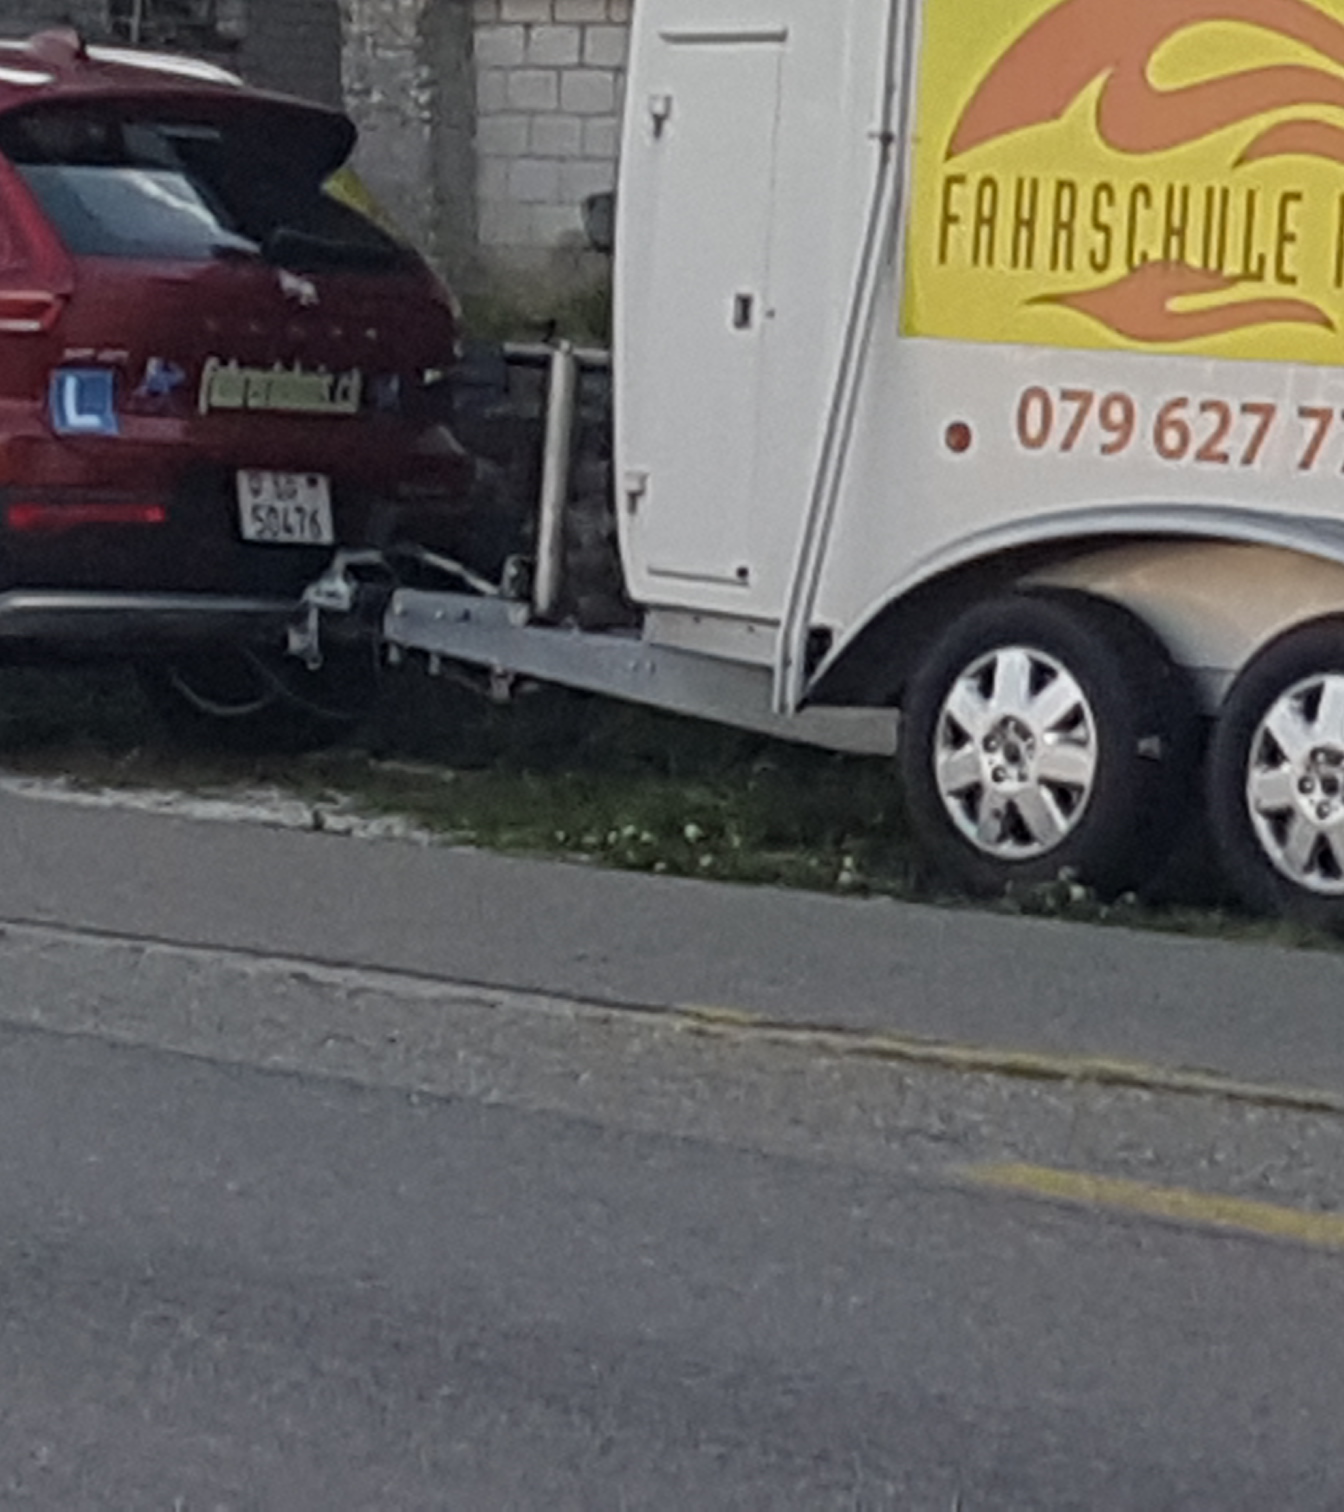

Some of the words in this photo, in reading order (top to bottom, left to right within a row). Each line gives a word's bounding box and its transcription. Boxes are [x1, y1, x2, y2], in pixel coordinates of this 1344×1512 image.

[938, 173, 1304, 287] FAHRSCHULE
[63, 373, 102, 428] L
[1016, 385, 1136, 455] 079
[1153, 395, 1277, 467] 627
